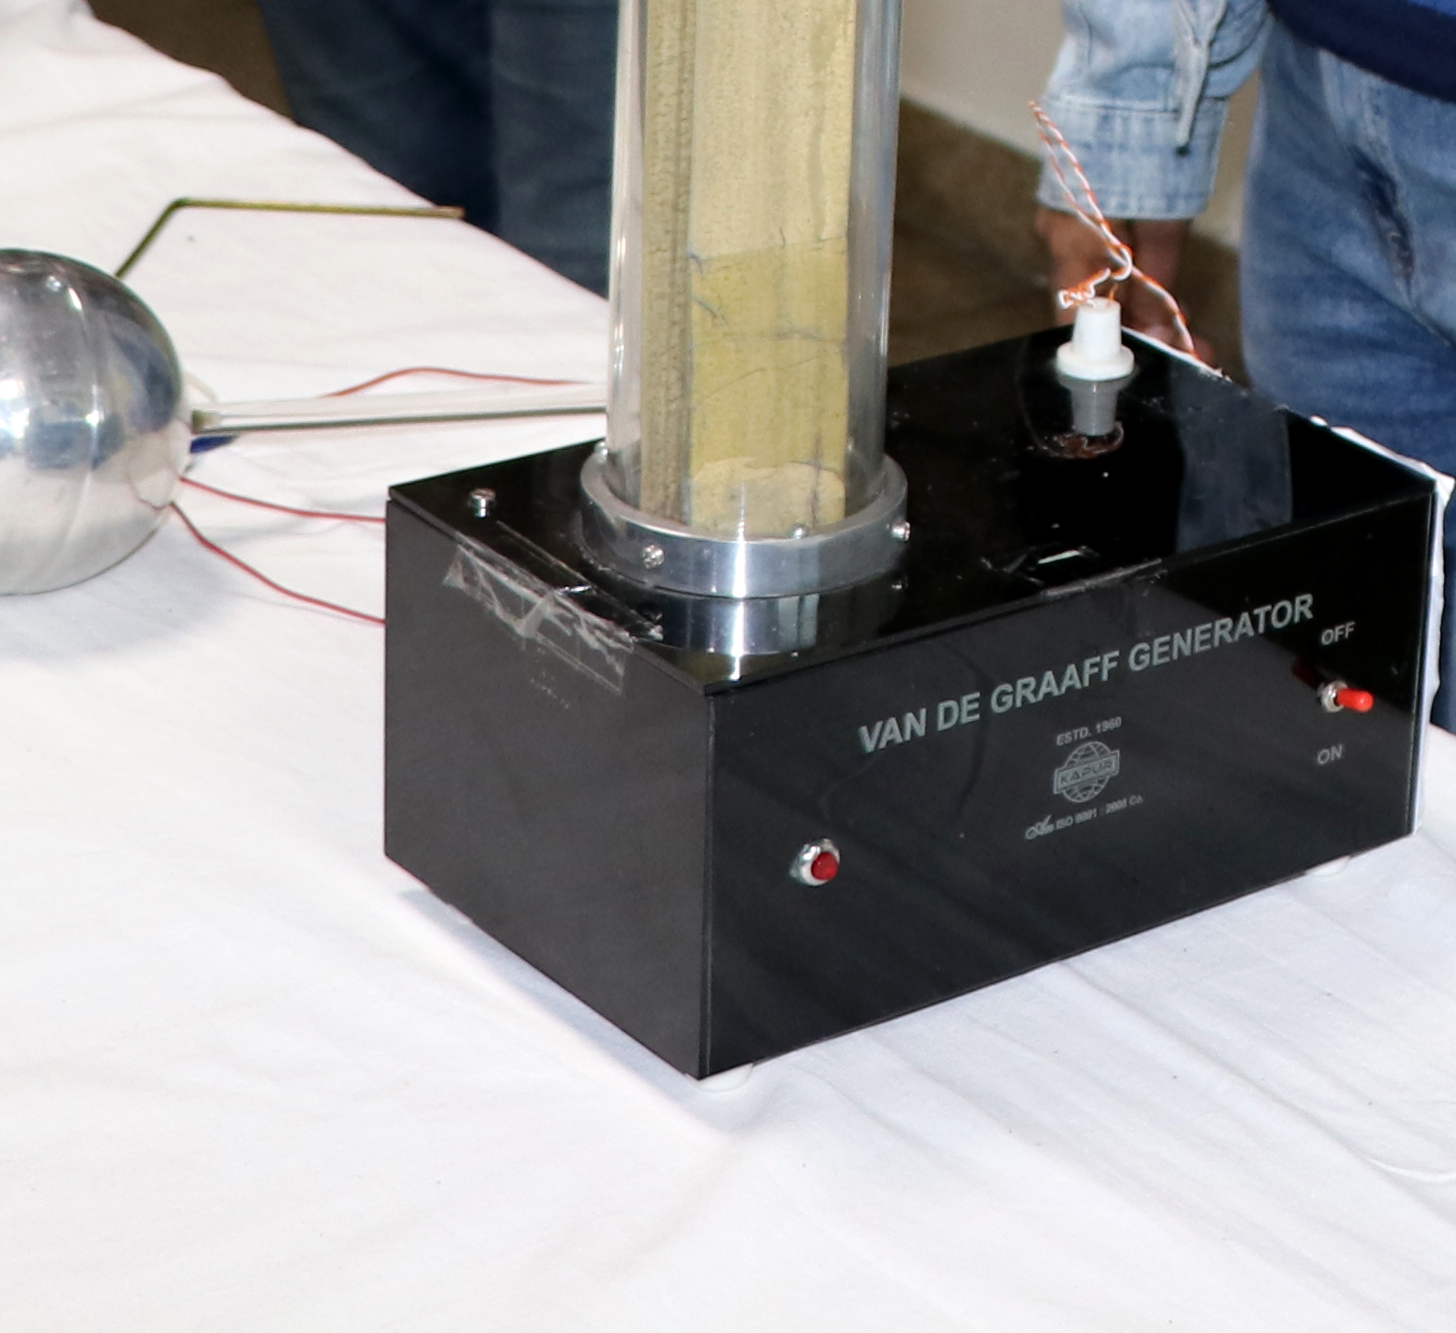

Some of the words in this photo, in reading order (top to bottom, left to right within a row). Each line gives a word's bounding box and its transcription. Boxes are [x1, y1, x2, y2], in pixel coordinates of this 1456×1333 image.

[1321, 622, 1356, 644] OFF
[858, 710, 927, 753] VAN
[937, 692, 980, 730] DE
[991, 651, 1120, 714] GRAAFF
[1128, 594, 1314, 672] GENERATOR
[1317, 744, 1342, 765] ON
[1060, 760, 1113, 783] KAPUR
